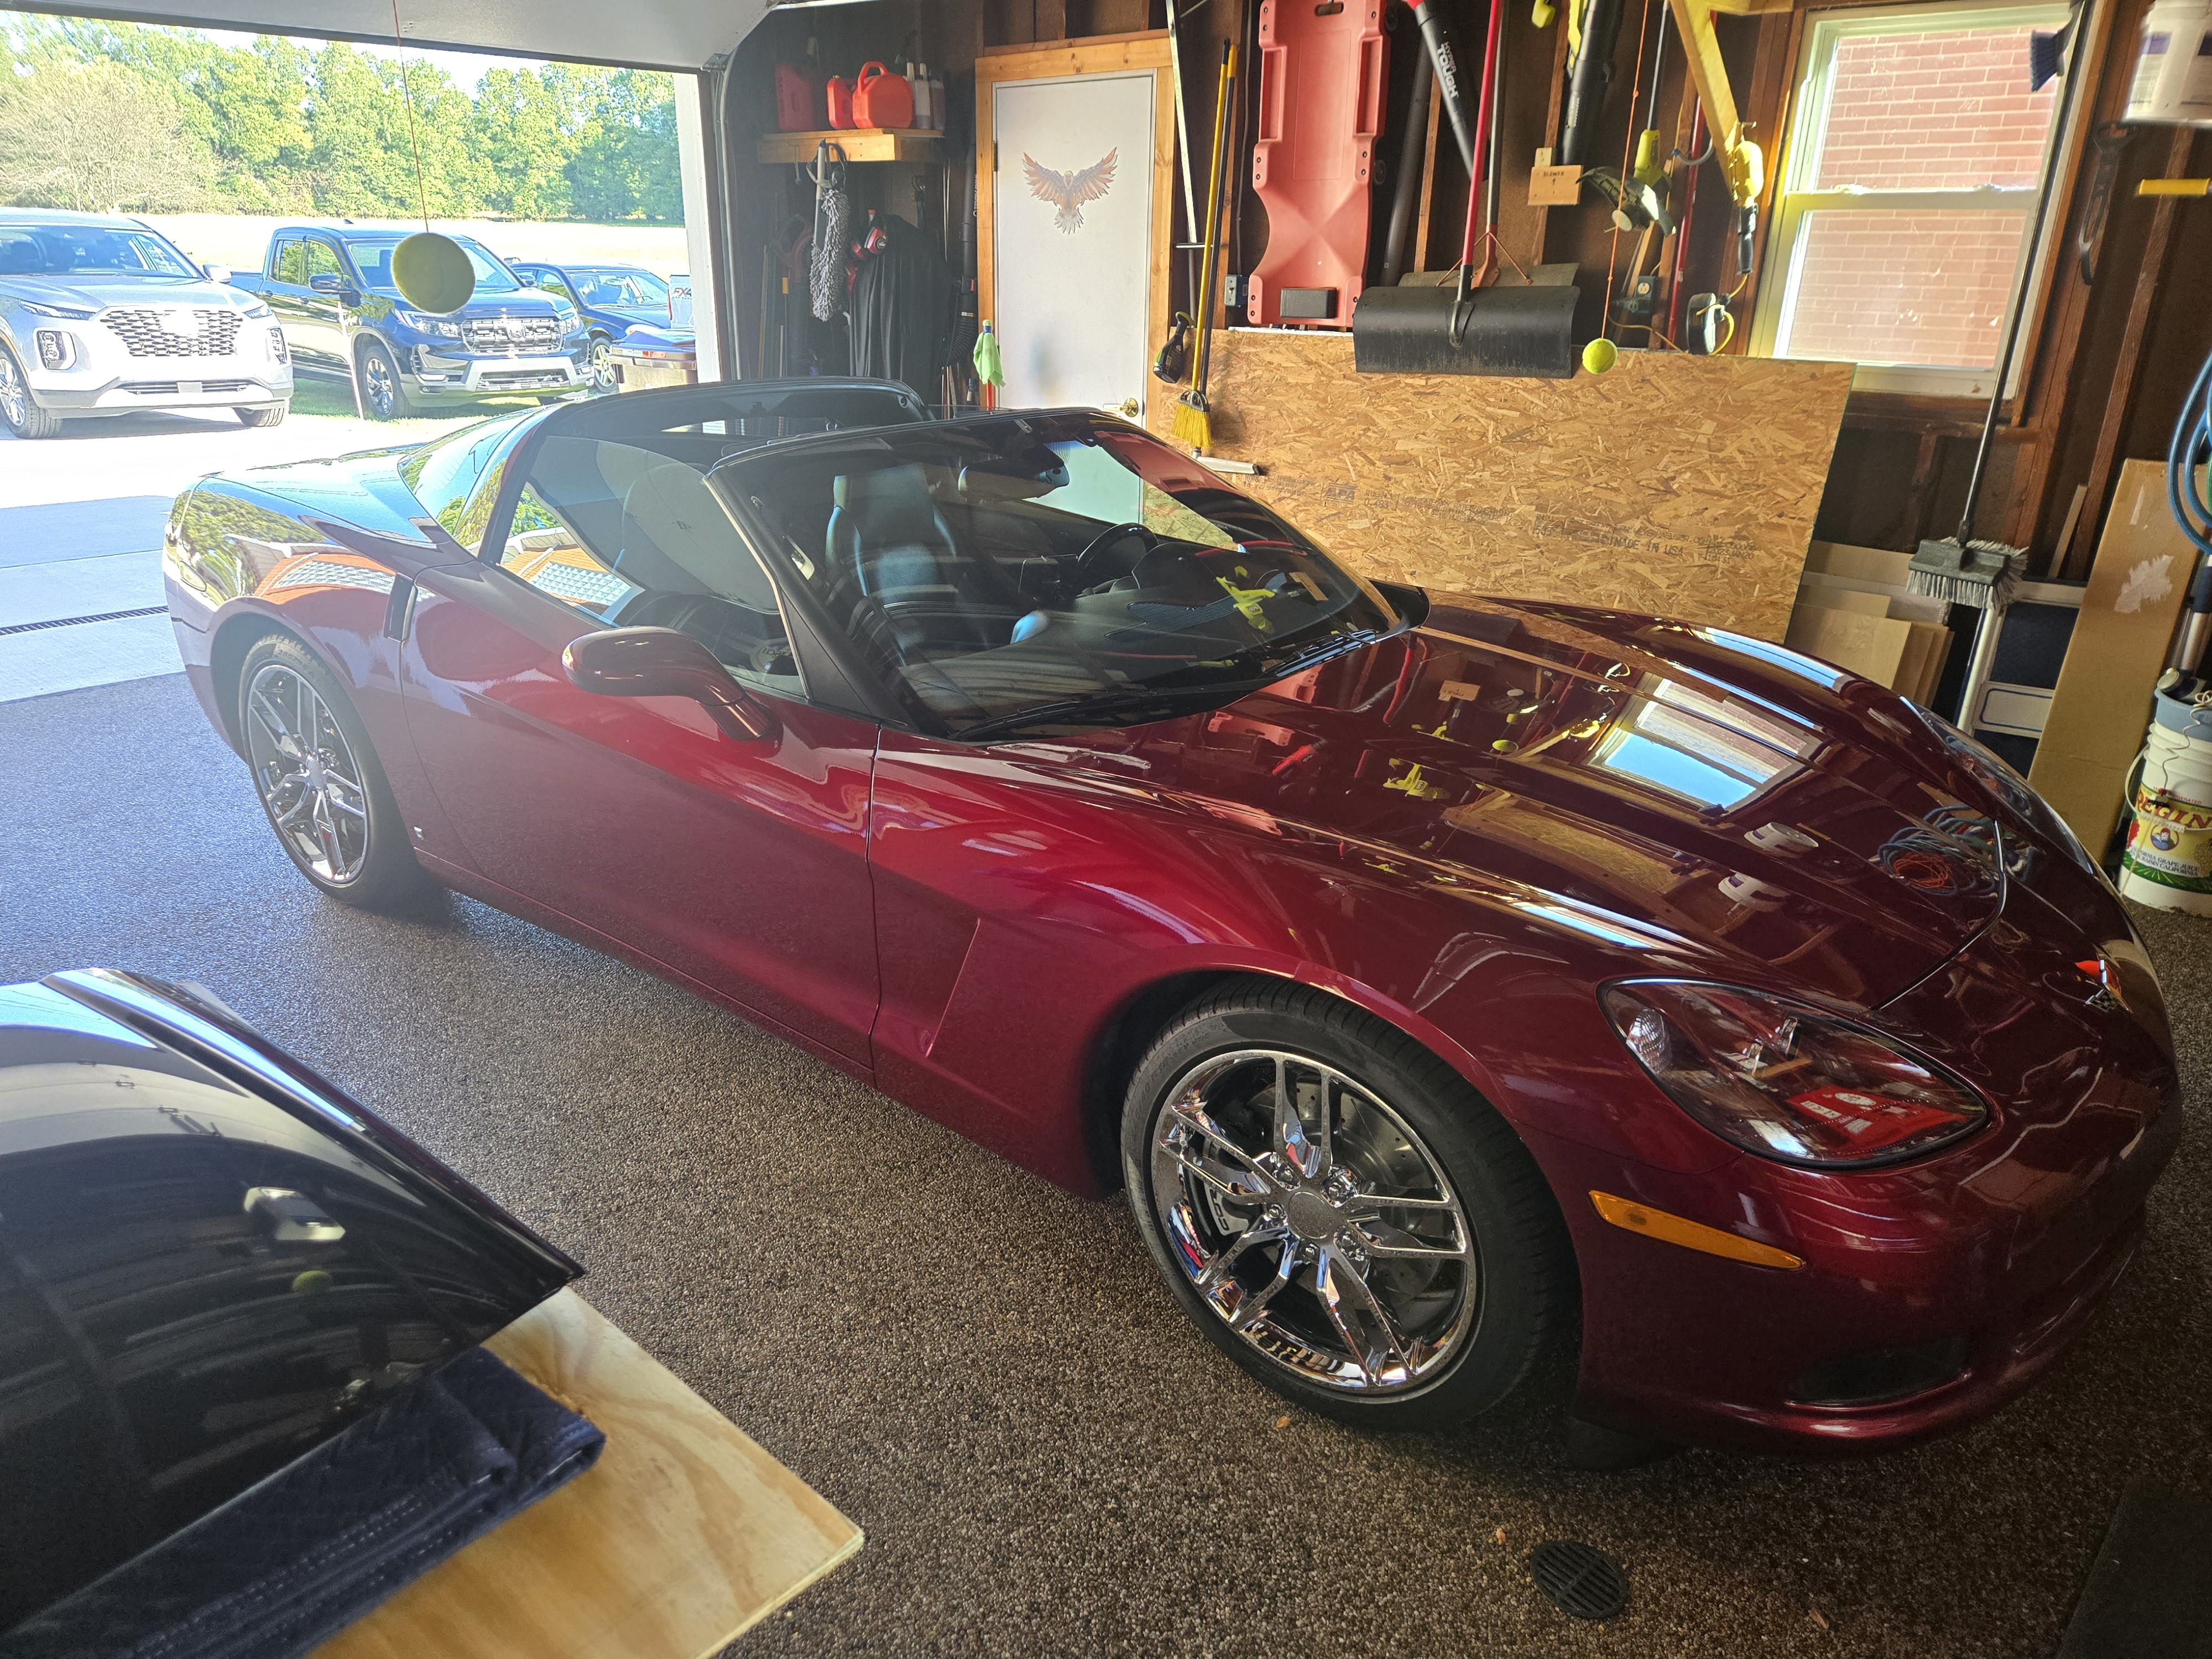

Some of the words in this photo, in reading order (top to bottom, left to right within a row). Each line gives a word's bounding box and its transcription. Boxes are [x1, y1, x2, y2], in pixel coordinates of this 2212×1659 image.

[1444, 41, 1457, 73] HYPER
[1437, 43, 1459, 98] TOUGH
[673, 287, 691, 296] FX4
[1614, 536, 1641, 550] MADE
[1646, 541, 1660, 553] IN
[1665, 544, 1683, 557] USA
[2157, 857, 2179, 867] GRAPE
